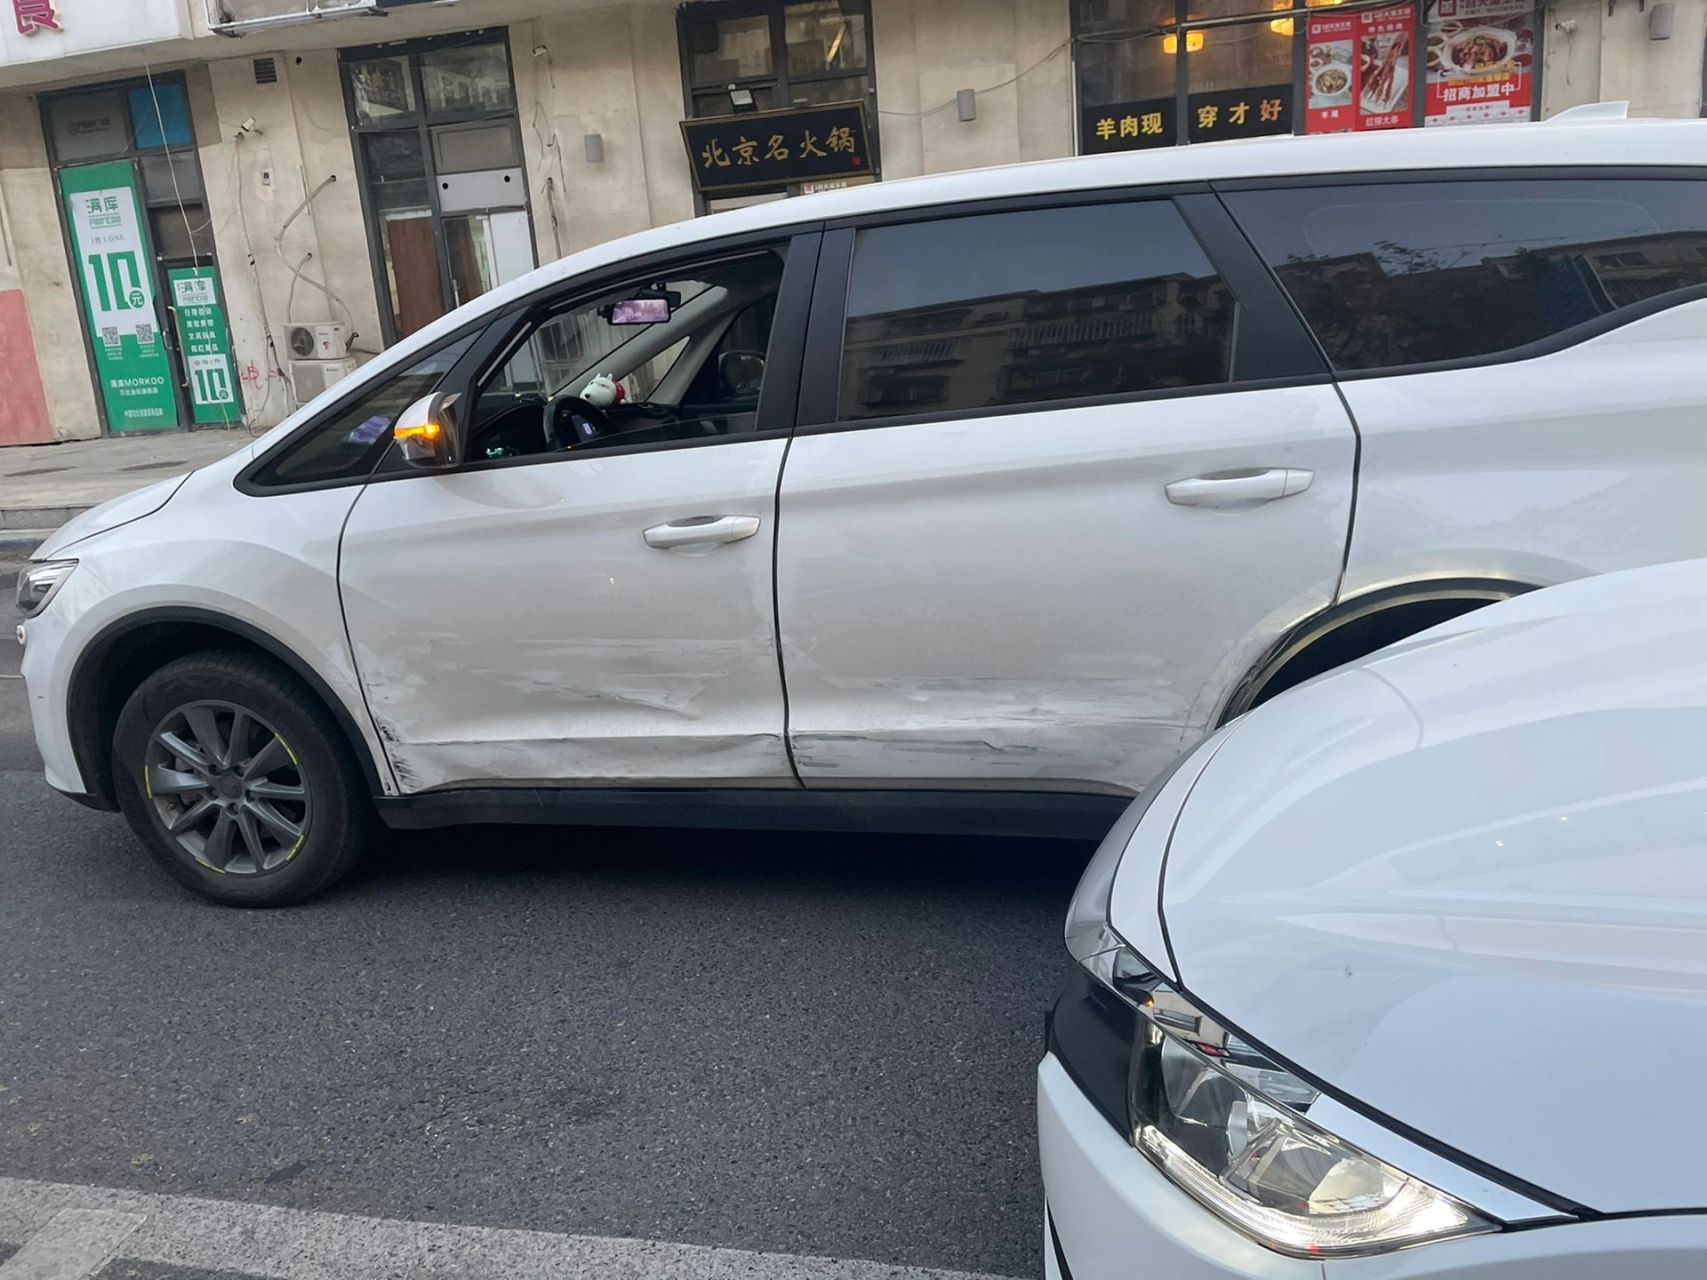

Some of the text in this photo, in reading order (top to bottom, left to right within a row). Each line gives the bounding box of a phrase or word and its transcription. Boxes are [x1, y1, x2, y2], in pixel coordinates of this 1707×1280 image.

[1443, 82, 1515, 102] 招商加盟中
[1096, 99, 1283, 140] 羊肉现 穿才好
[702, 126, 855, 168] 北京名火锅
[85, 195, 119, 214] 满库
[88, 250, 143, 312] 10
[194, 368, 227, 402] 10
